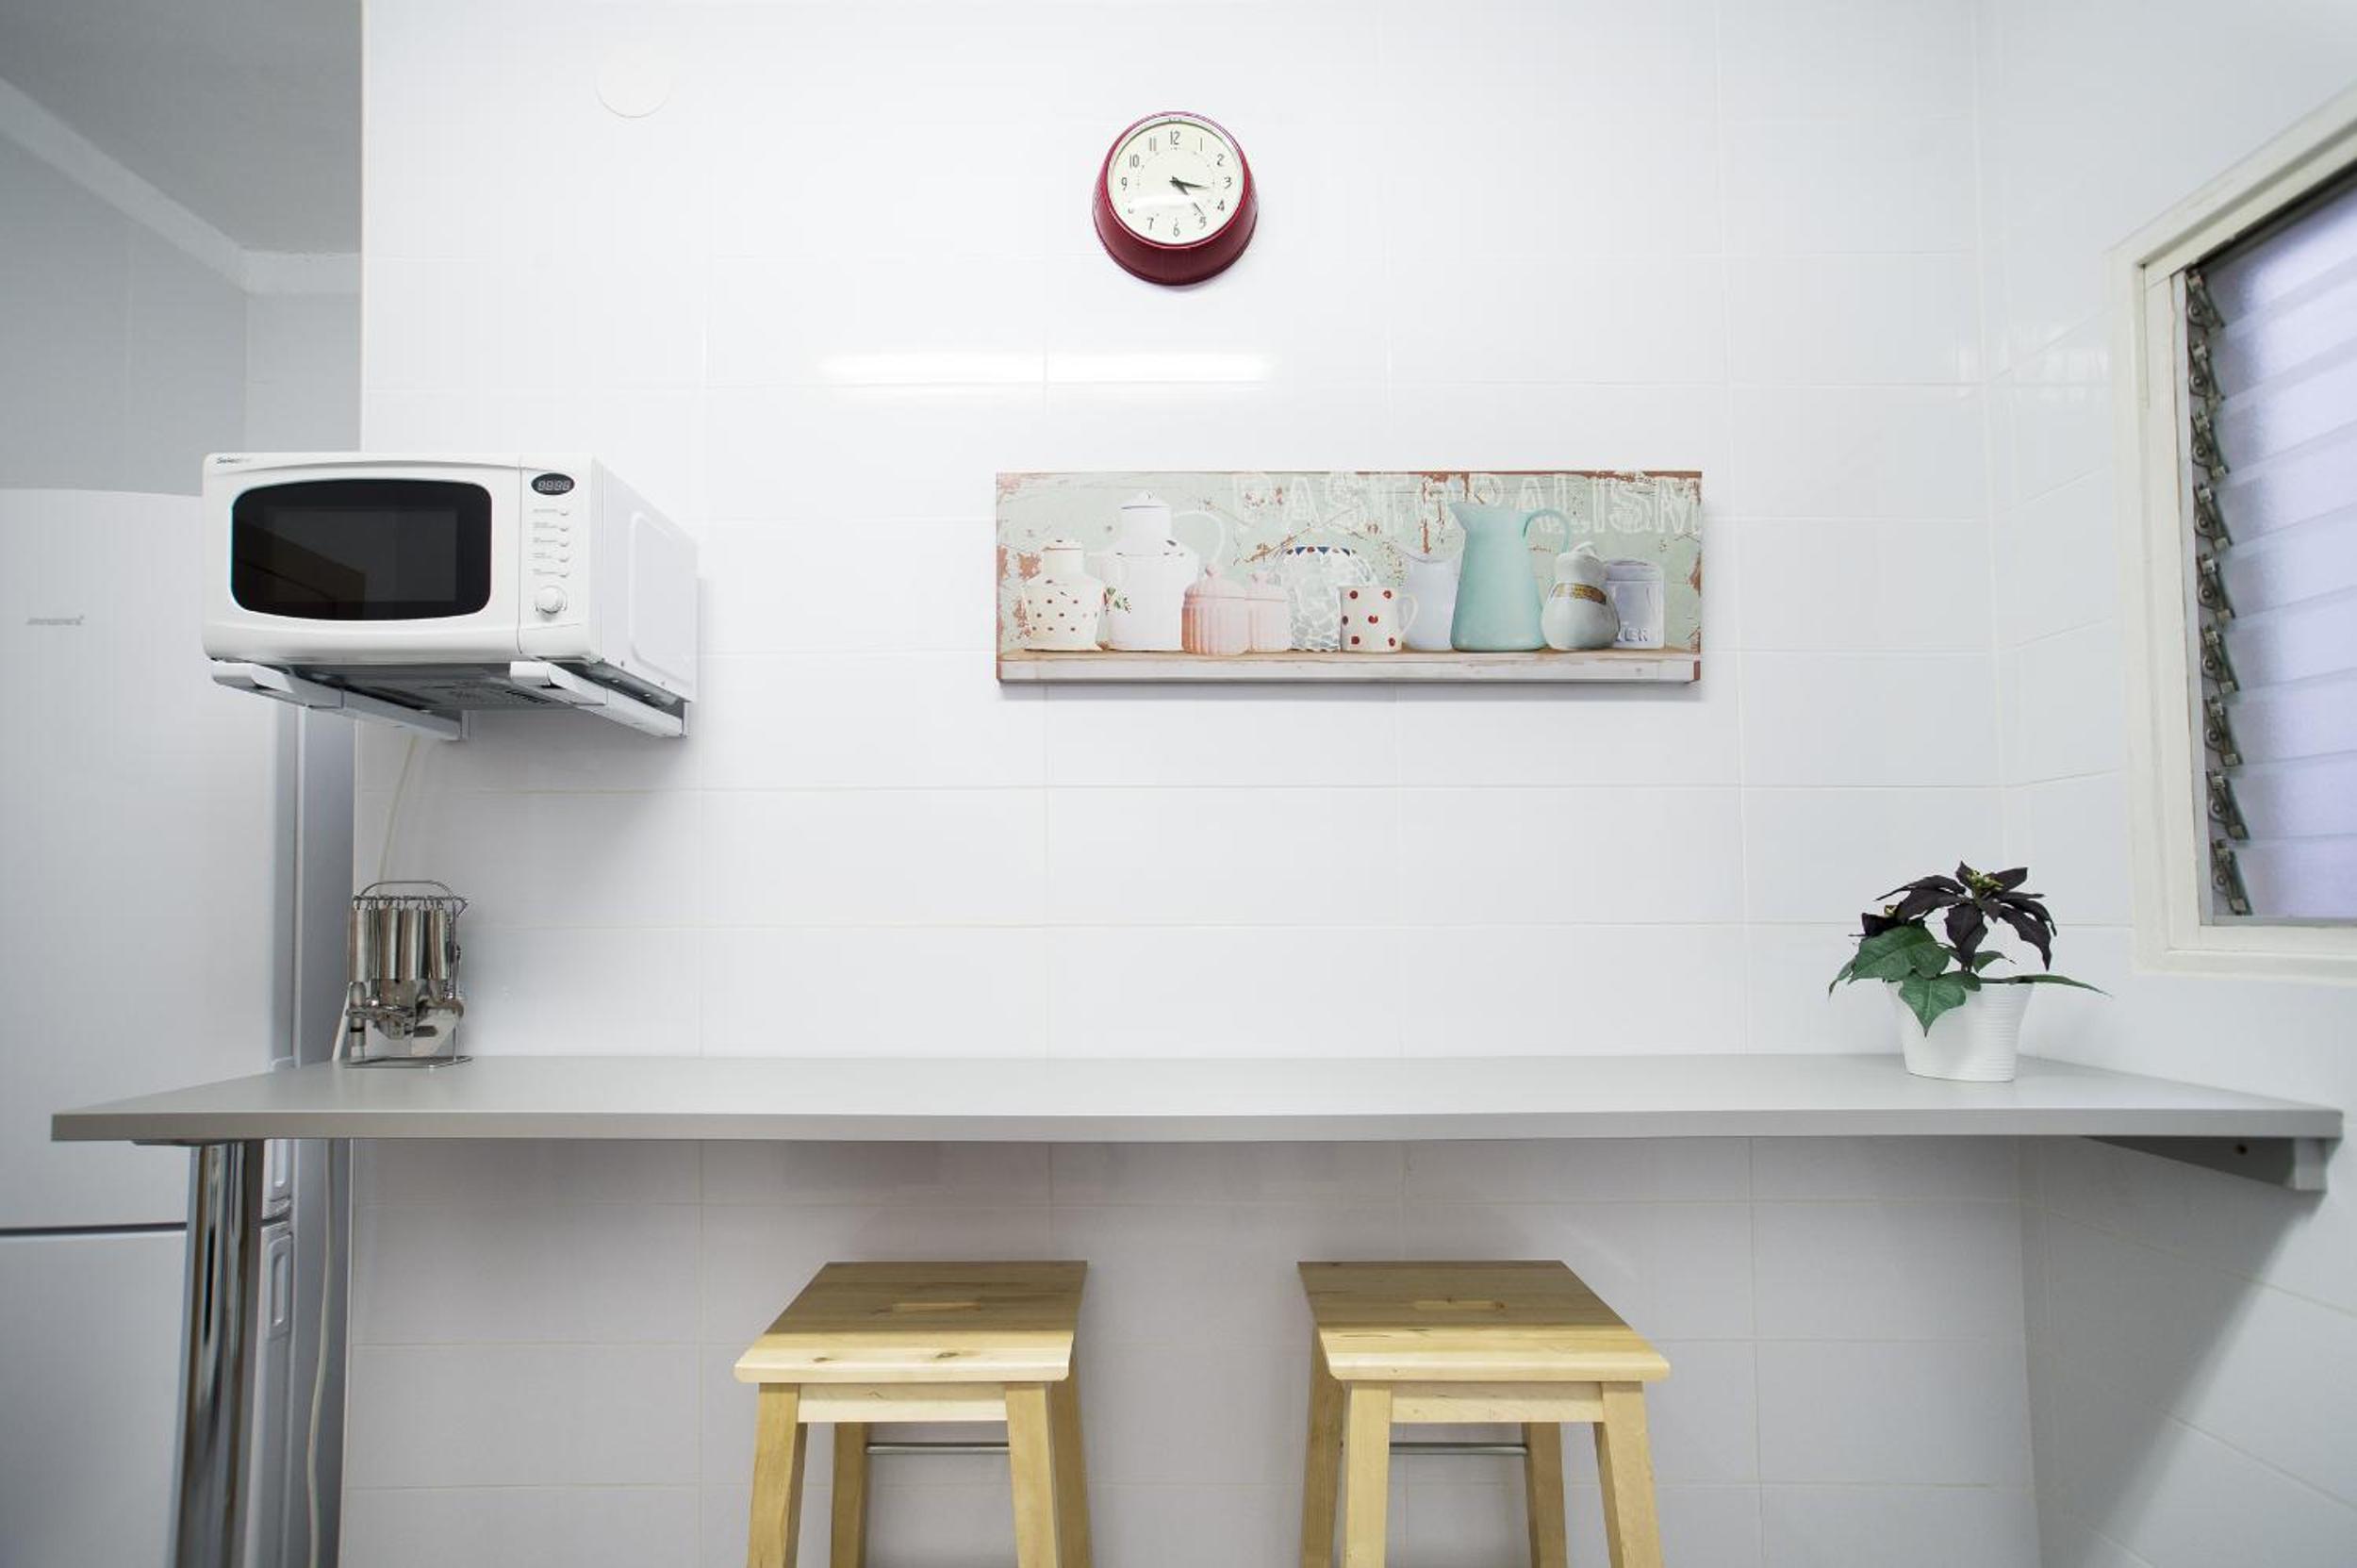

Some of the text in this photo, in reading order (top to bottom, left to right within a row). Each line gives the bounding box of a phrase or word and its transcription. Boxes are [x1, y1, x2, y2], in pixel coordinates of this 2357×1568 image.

[1148, 137, 1158, 152] 11
[1169, 130, 1180, 146] 12
[1129, 154, 1140, 169] 10
[1216, 154, 1225, 168] 2
[1120, 176, 1129, 190] 9
[1224, 176, 1233, 190] 3
[1216, 199, 1226, 212] 4
[1146, 217, 1155, 231] 7
[1198, 216, 1208, 230] 5
[1172, 223, 1181, 239] 6
